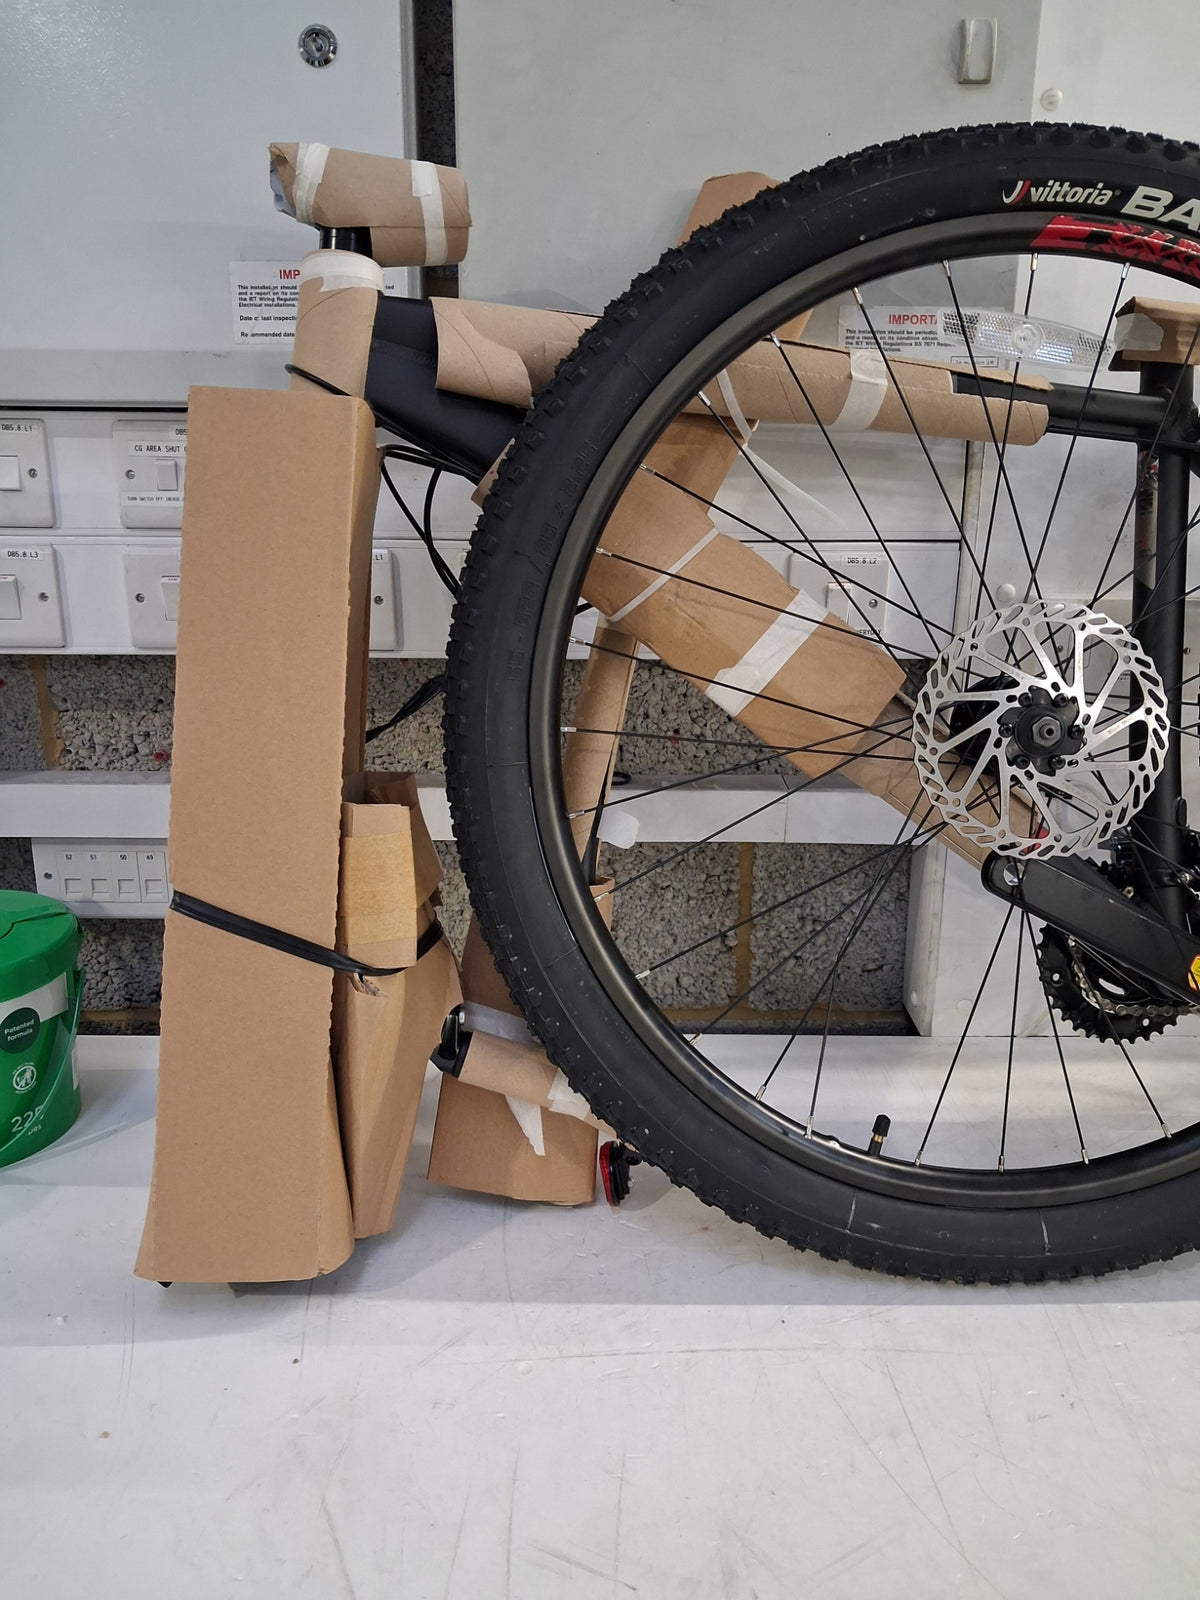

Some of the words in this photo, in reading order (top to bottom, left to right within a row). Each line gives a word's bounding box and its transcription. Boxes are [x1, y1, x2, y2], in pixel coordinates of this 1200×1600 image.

[1030, 179, 1113, 206] vittoria
[4, 1019, 35, 1035] Patented
[7, 1028, 33, 1041] formula
